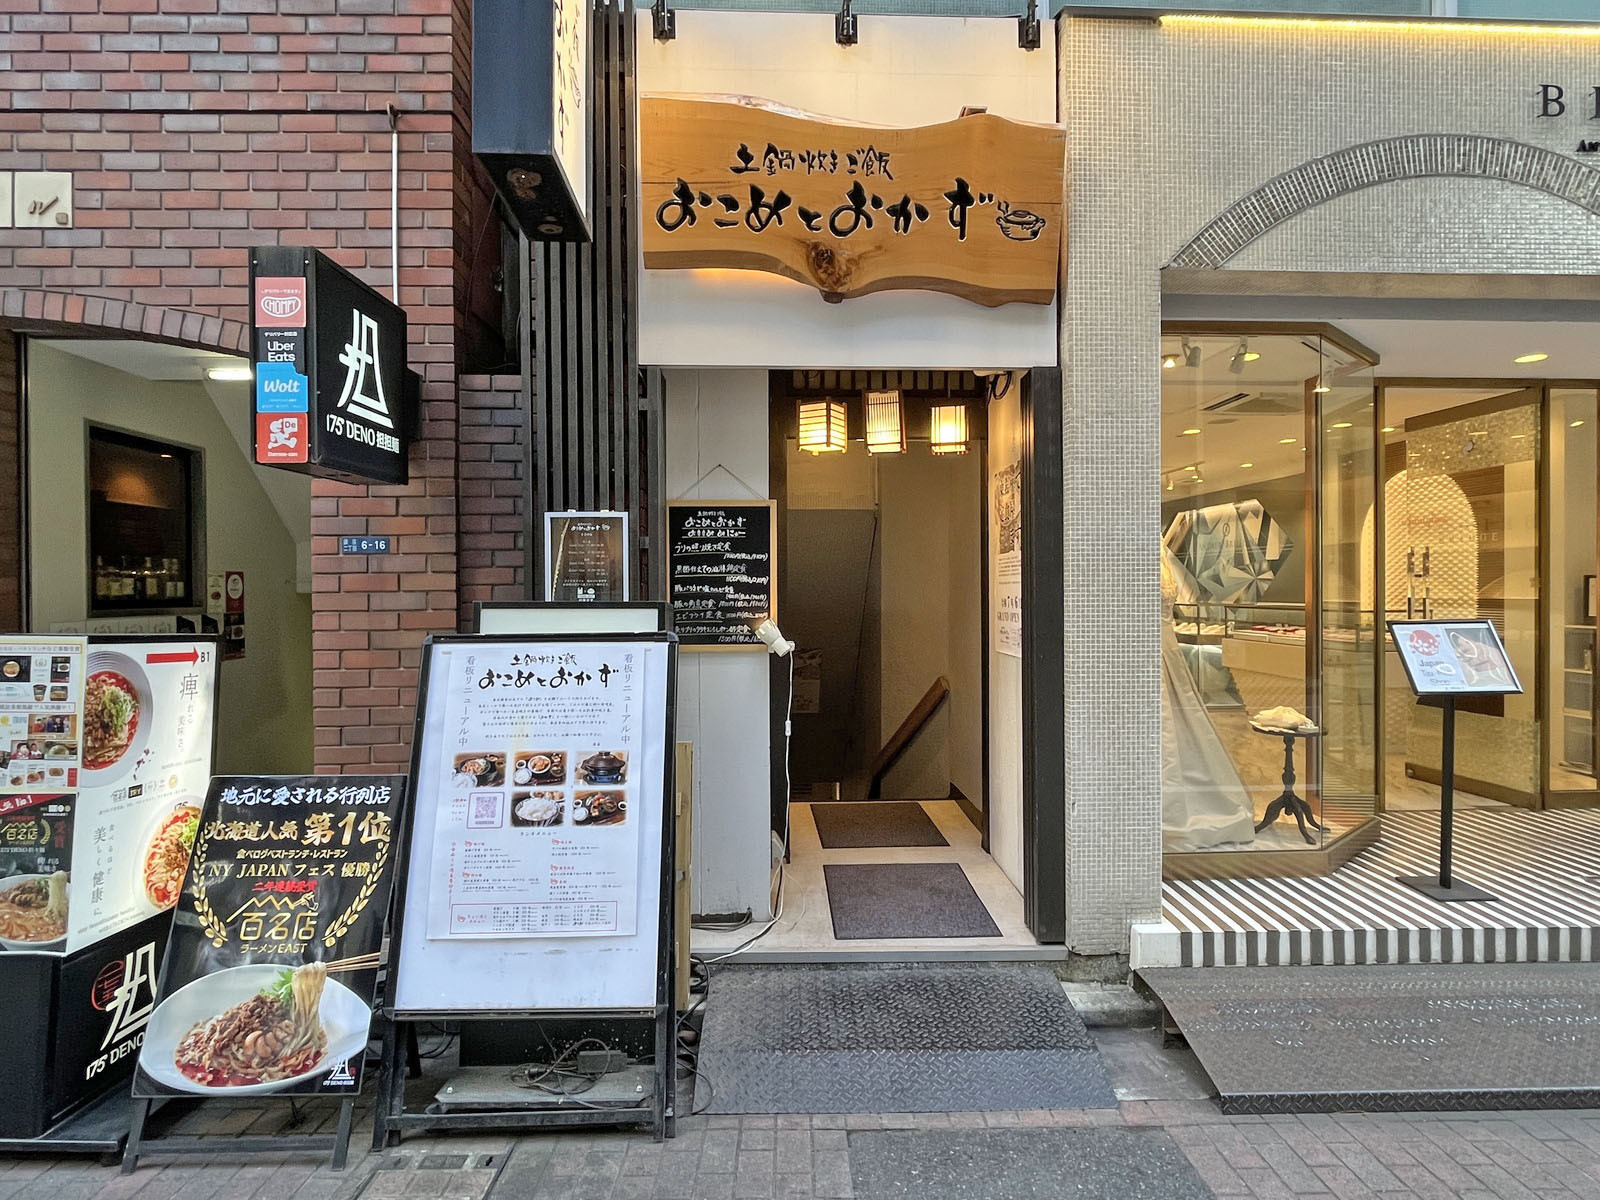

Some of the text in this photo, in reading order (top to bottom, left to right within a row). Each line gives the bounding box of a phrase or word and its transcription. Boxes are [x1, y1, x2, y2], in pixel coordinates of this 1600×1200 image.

[729, 142, 894, 180] 土鍋炊きご飯
[655, 176, 995, 241] おこめとおかず
[267, 341, 295, 351] Uber
[268, 351, 296, 362] Eats
[264, 379, 300, 393] Wolt
[361, 540, 386, 550] 6-16
[201, 651, 210, 662] B1
[478, 663, 620, 689] おこめとおかず
[459, 655, 475, 747] 看板リニューアル中
[621, 653, 634, 745] 看板リニューアル中
[220, 786, 391, 806] 地元に愛される行列店
[6, 828, 38, 840] 百名店
[204, 811, 392, 846] 北海道人気 第1位
[236, 848, 348, 859] 食べログベストランチ・レストラン
[209, 861, 371, 878] NY JAPAN フェス 優勝
[240, 910, 319, 941] 百名店
[240, 943, 308, 954] ラーメンEAST
